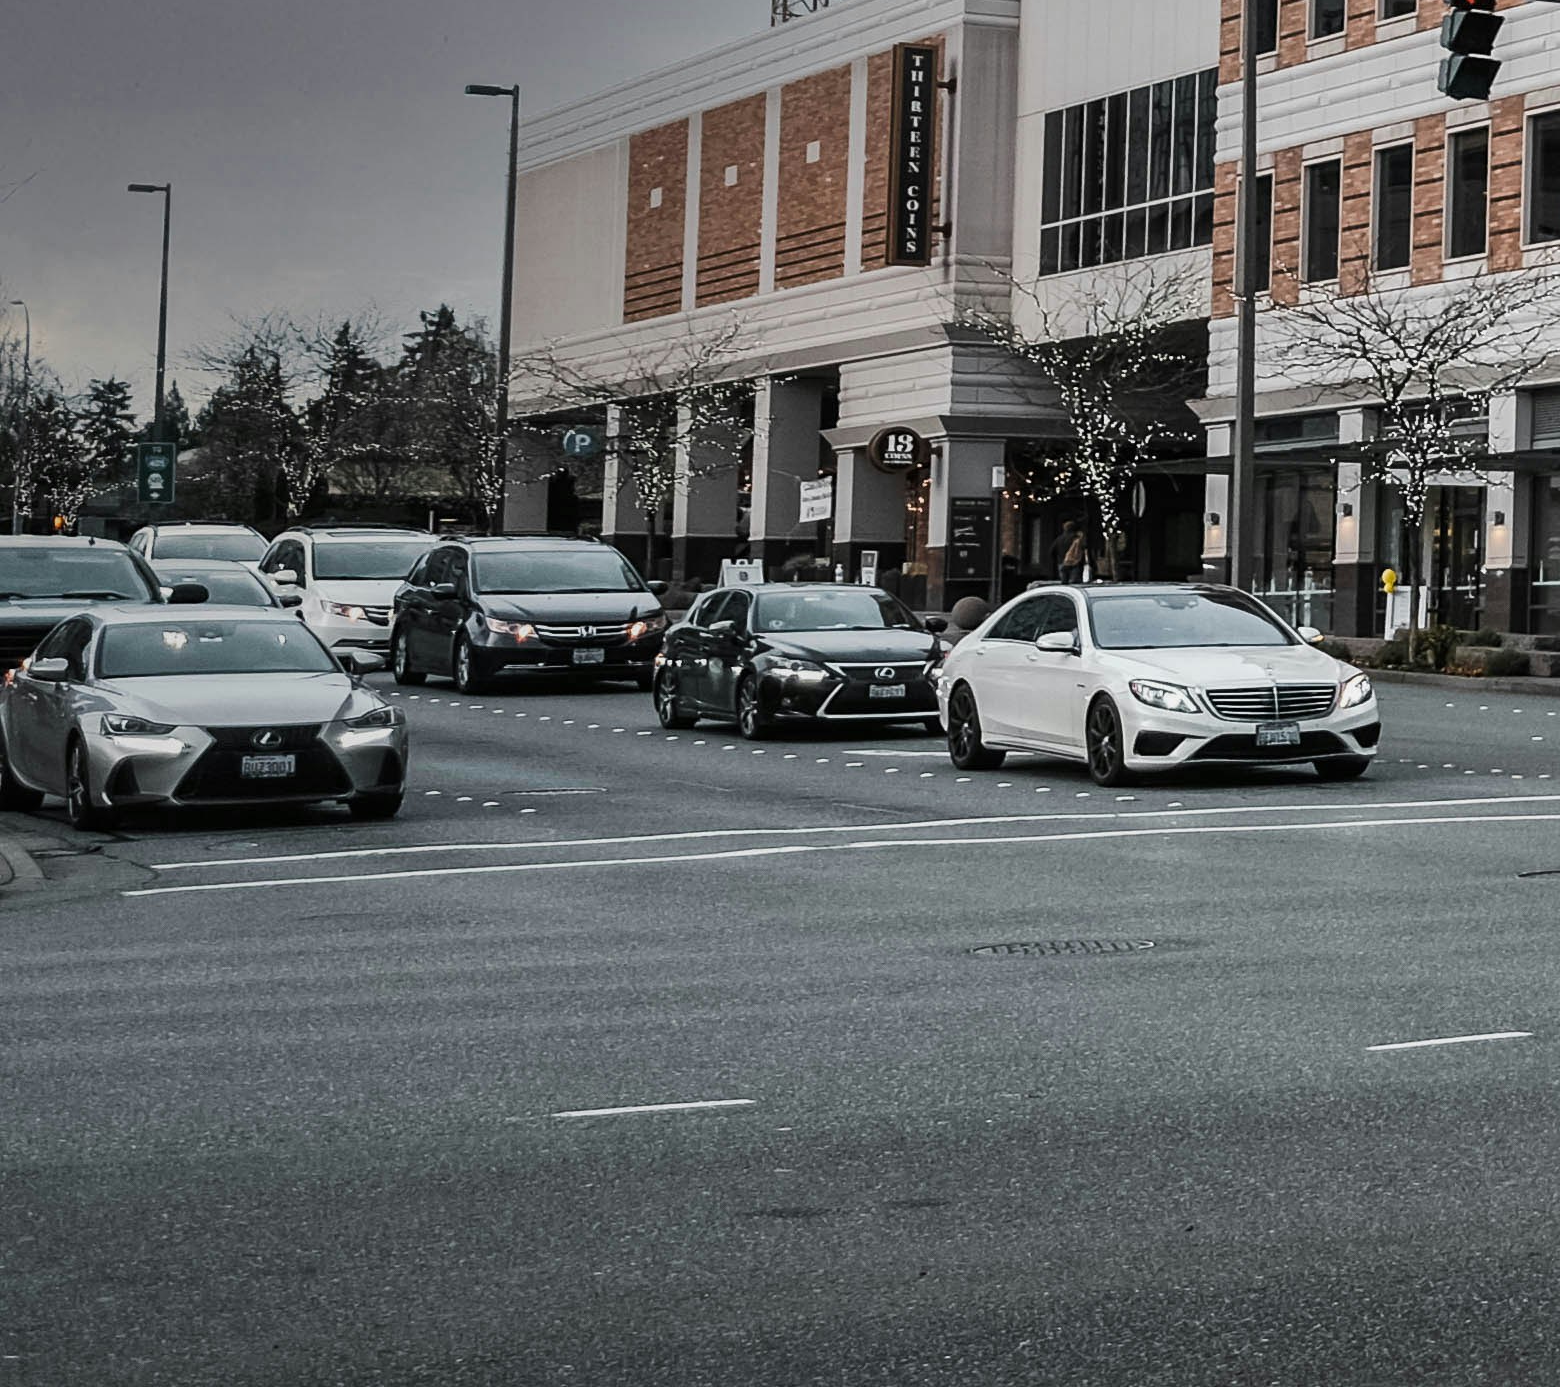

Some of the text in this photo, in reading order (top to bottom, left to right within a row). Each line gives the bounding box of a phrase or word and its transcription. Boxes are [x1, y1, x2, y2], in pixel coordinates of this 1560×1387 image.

[905, 54, 924, 254] THIRTEEN COINS
[575, 434, 591, 452] P
[887, 434, 914, 453] 13
